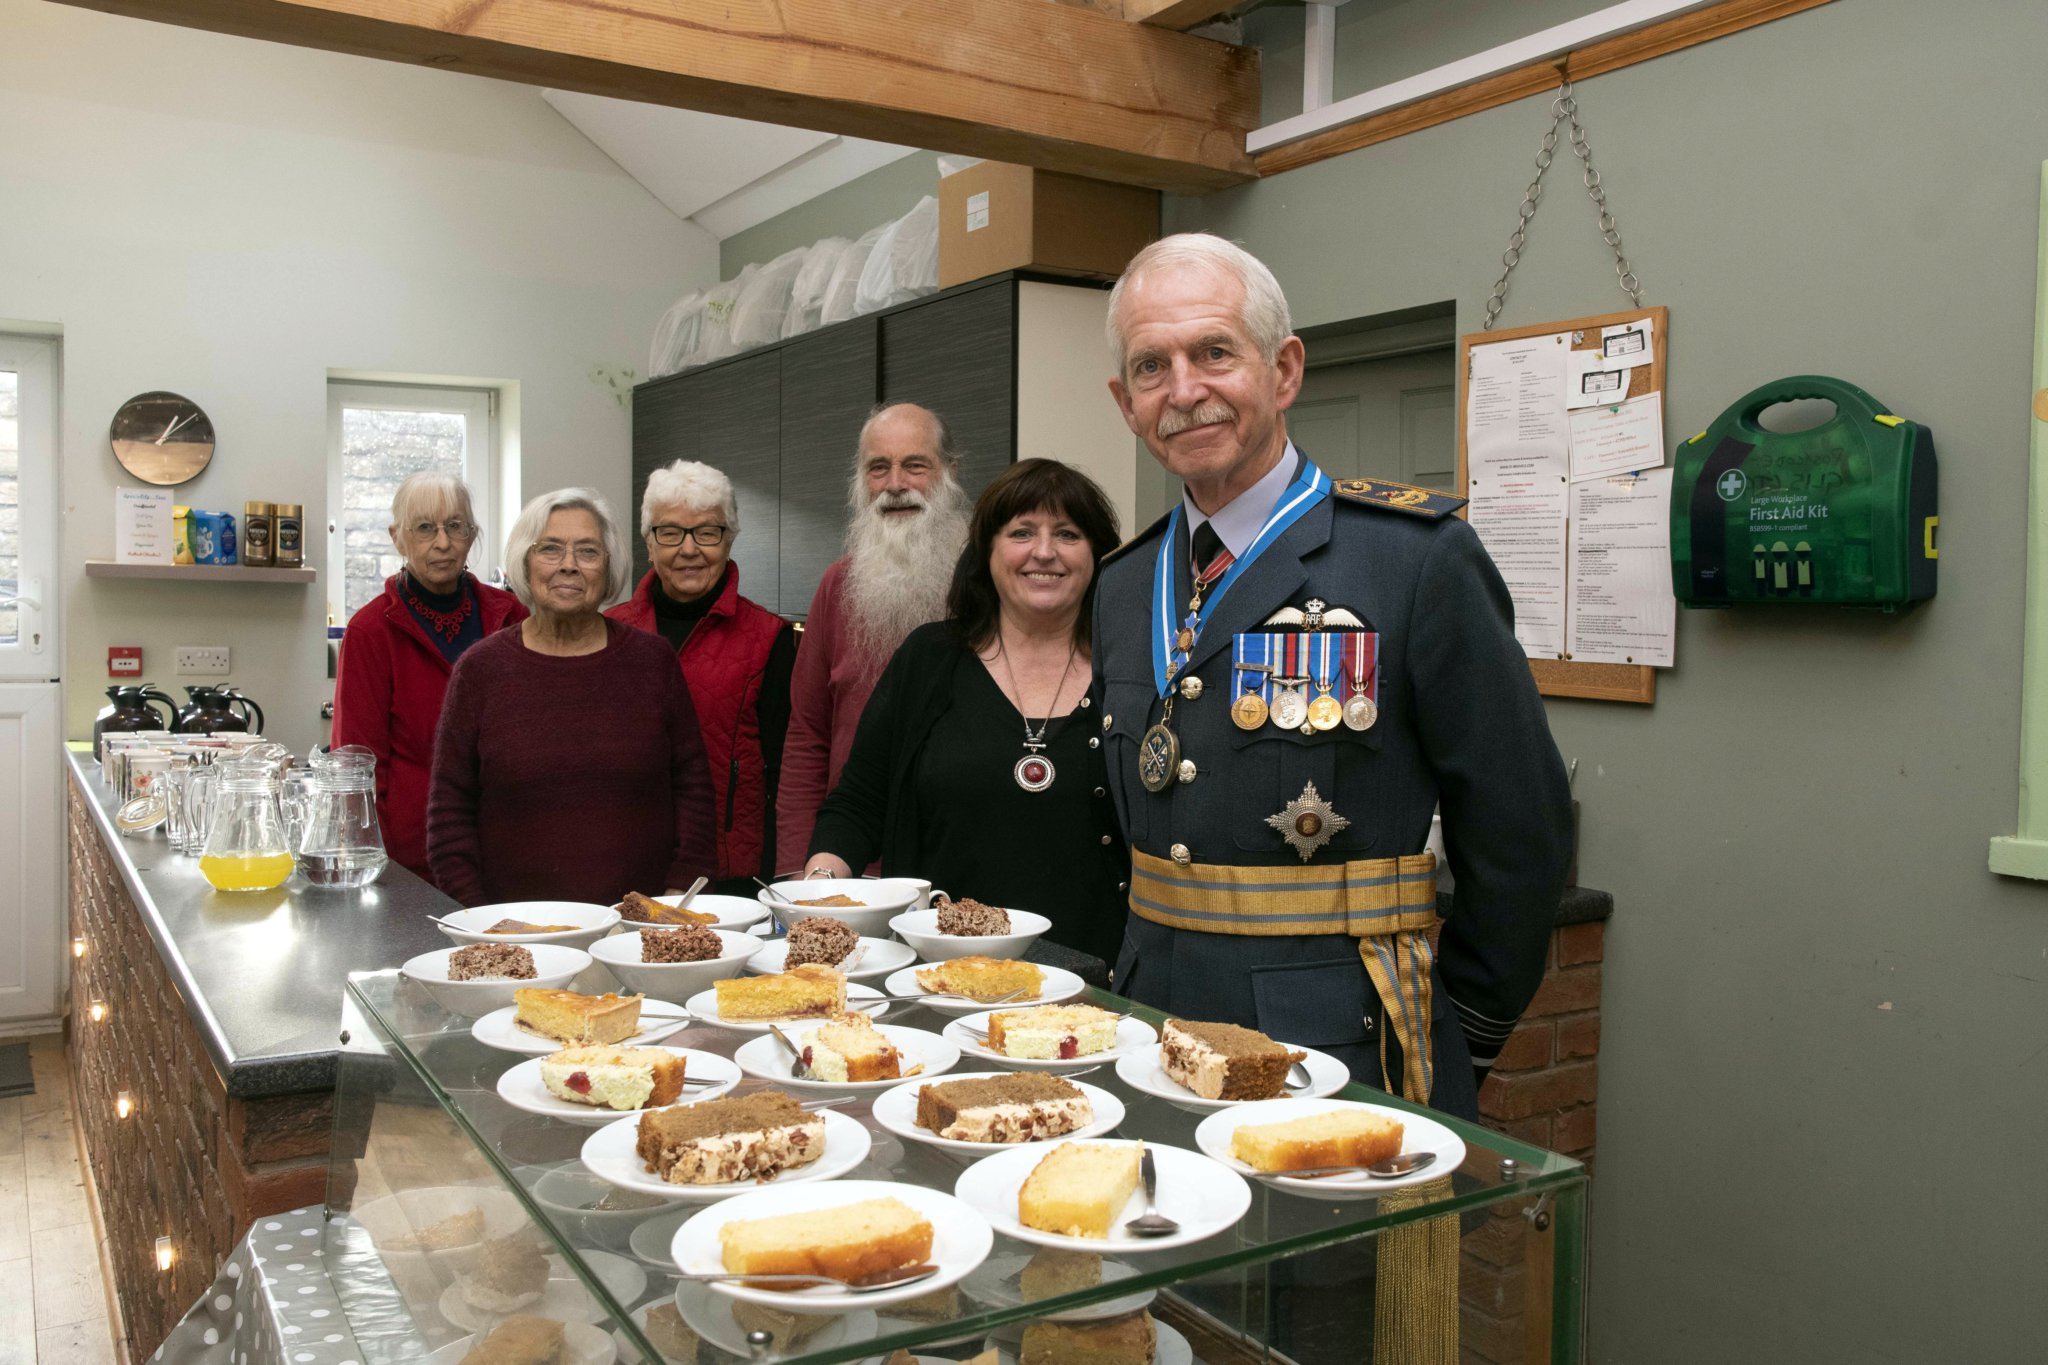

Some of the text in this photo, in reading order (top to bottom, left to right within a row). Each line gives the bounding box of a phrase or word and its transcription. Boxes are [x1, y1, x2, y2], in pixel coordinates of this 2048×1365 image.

[1750, 494, 1808, 505] Large Workplace
[1750, 505, 1829, 521] First Aid Kit
[1778, 524, 1808, 532] compliant
